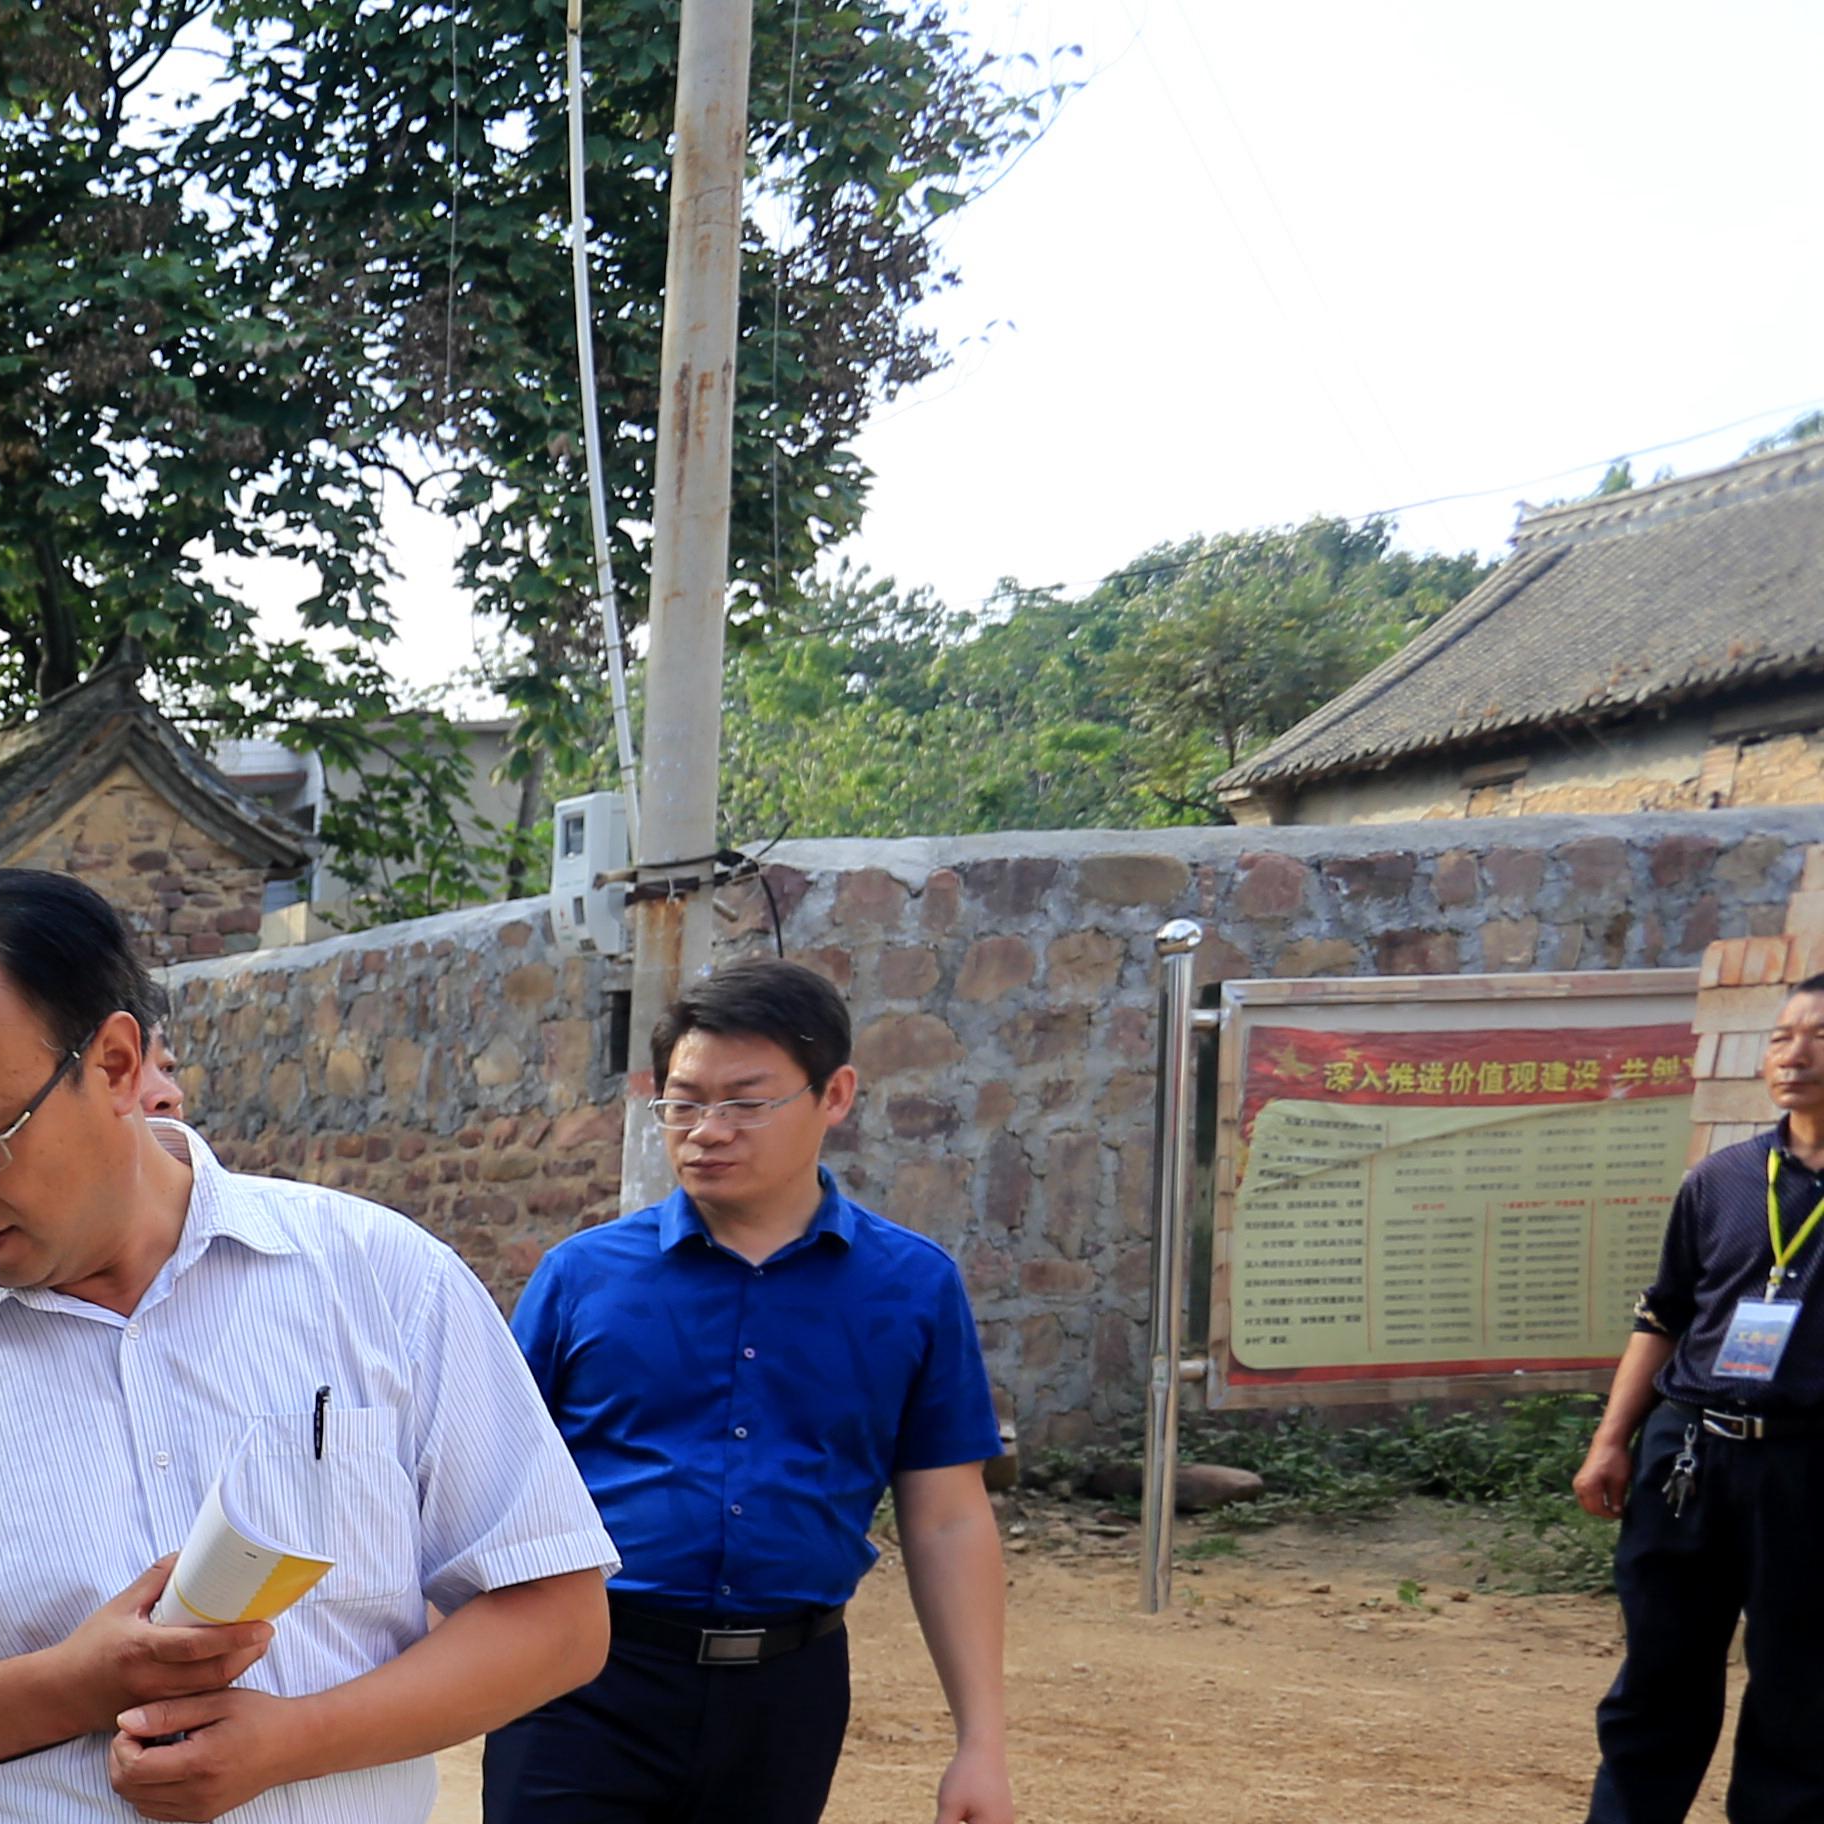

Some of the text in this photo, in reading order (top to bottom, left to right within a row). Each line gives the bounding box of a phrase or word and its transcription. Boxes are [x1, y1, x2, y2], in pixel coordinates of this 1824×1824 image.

[1324, 1059, 1600, 1095] 深入推进价值观建设
